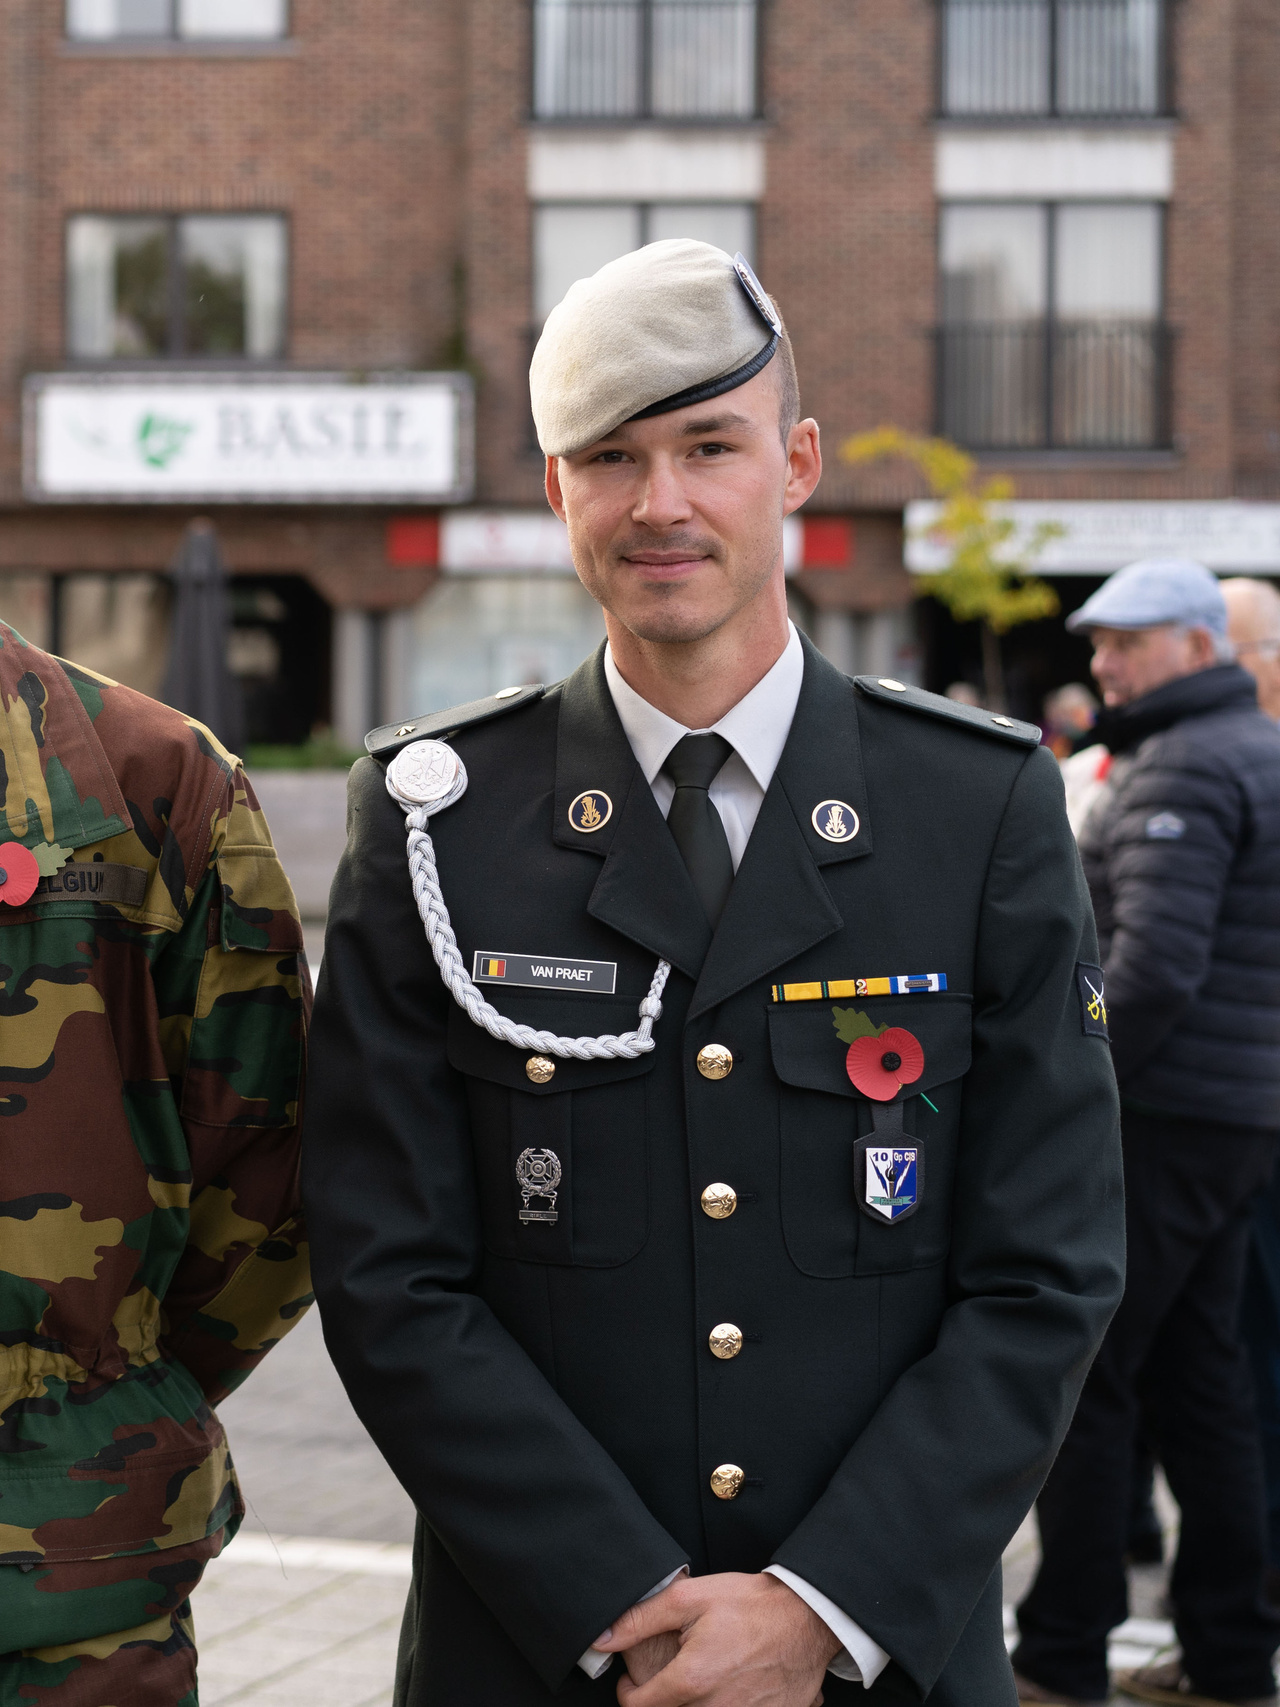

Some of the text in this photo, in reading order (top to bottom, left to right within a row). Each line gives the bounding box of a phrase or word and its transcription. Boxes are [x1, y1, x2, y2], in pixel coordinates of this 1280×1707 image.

[217, 402, 428, 457] BASIL
[37, 871, 105, 893] ELGIU
[530, 965, 593, 981] VAN PRAET
[856, 979, 867, 995] 2
[872, 1152, 889, 1162] 10
